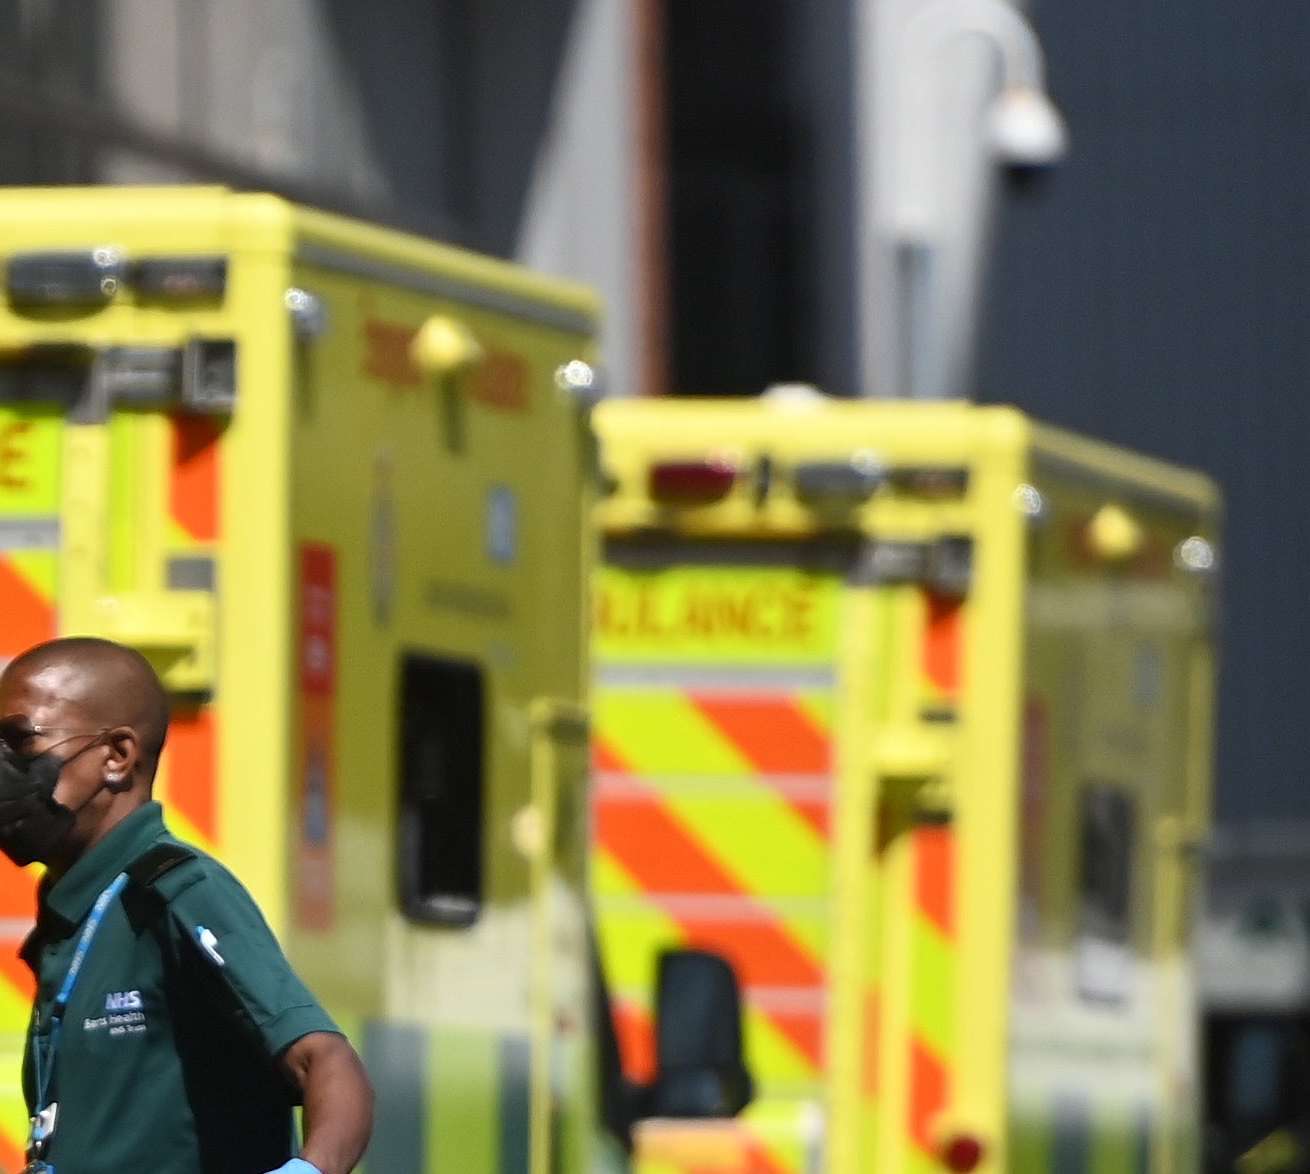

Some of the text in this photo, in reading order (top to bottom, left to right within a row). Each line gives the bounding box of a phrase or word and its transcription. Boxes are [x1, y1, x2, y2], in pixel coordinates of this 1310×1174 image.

[594, 576, 816, 638] ULANCE
[105, 990, 142, 1010] NHS
[109, 1011, 146, 1025] Health
